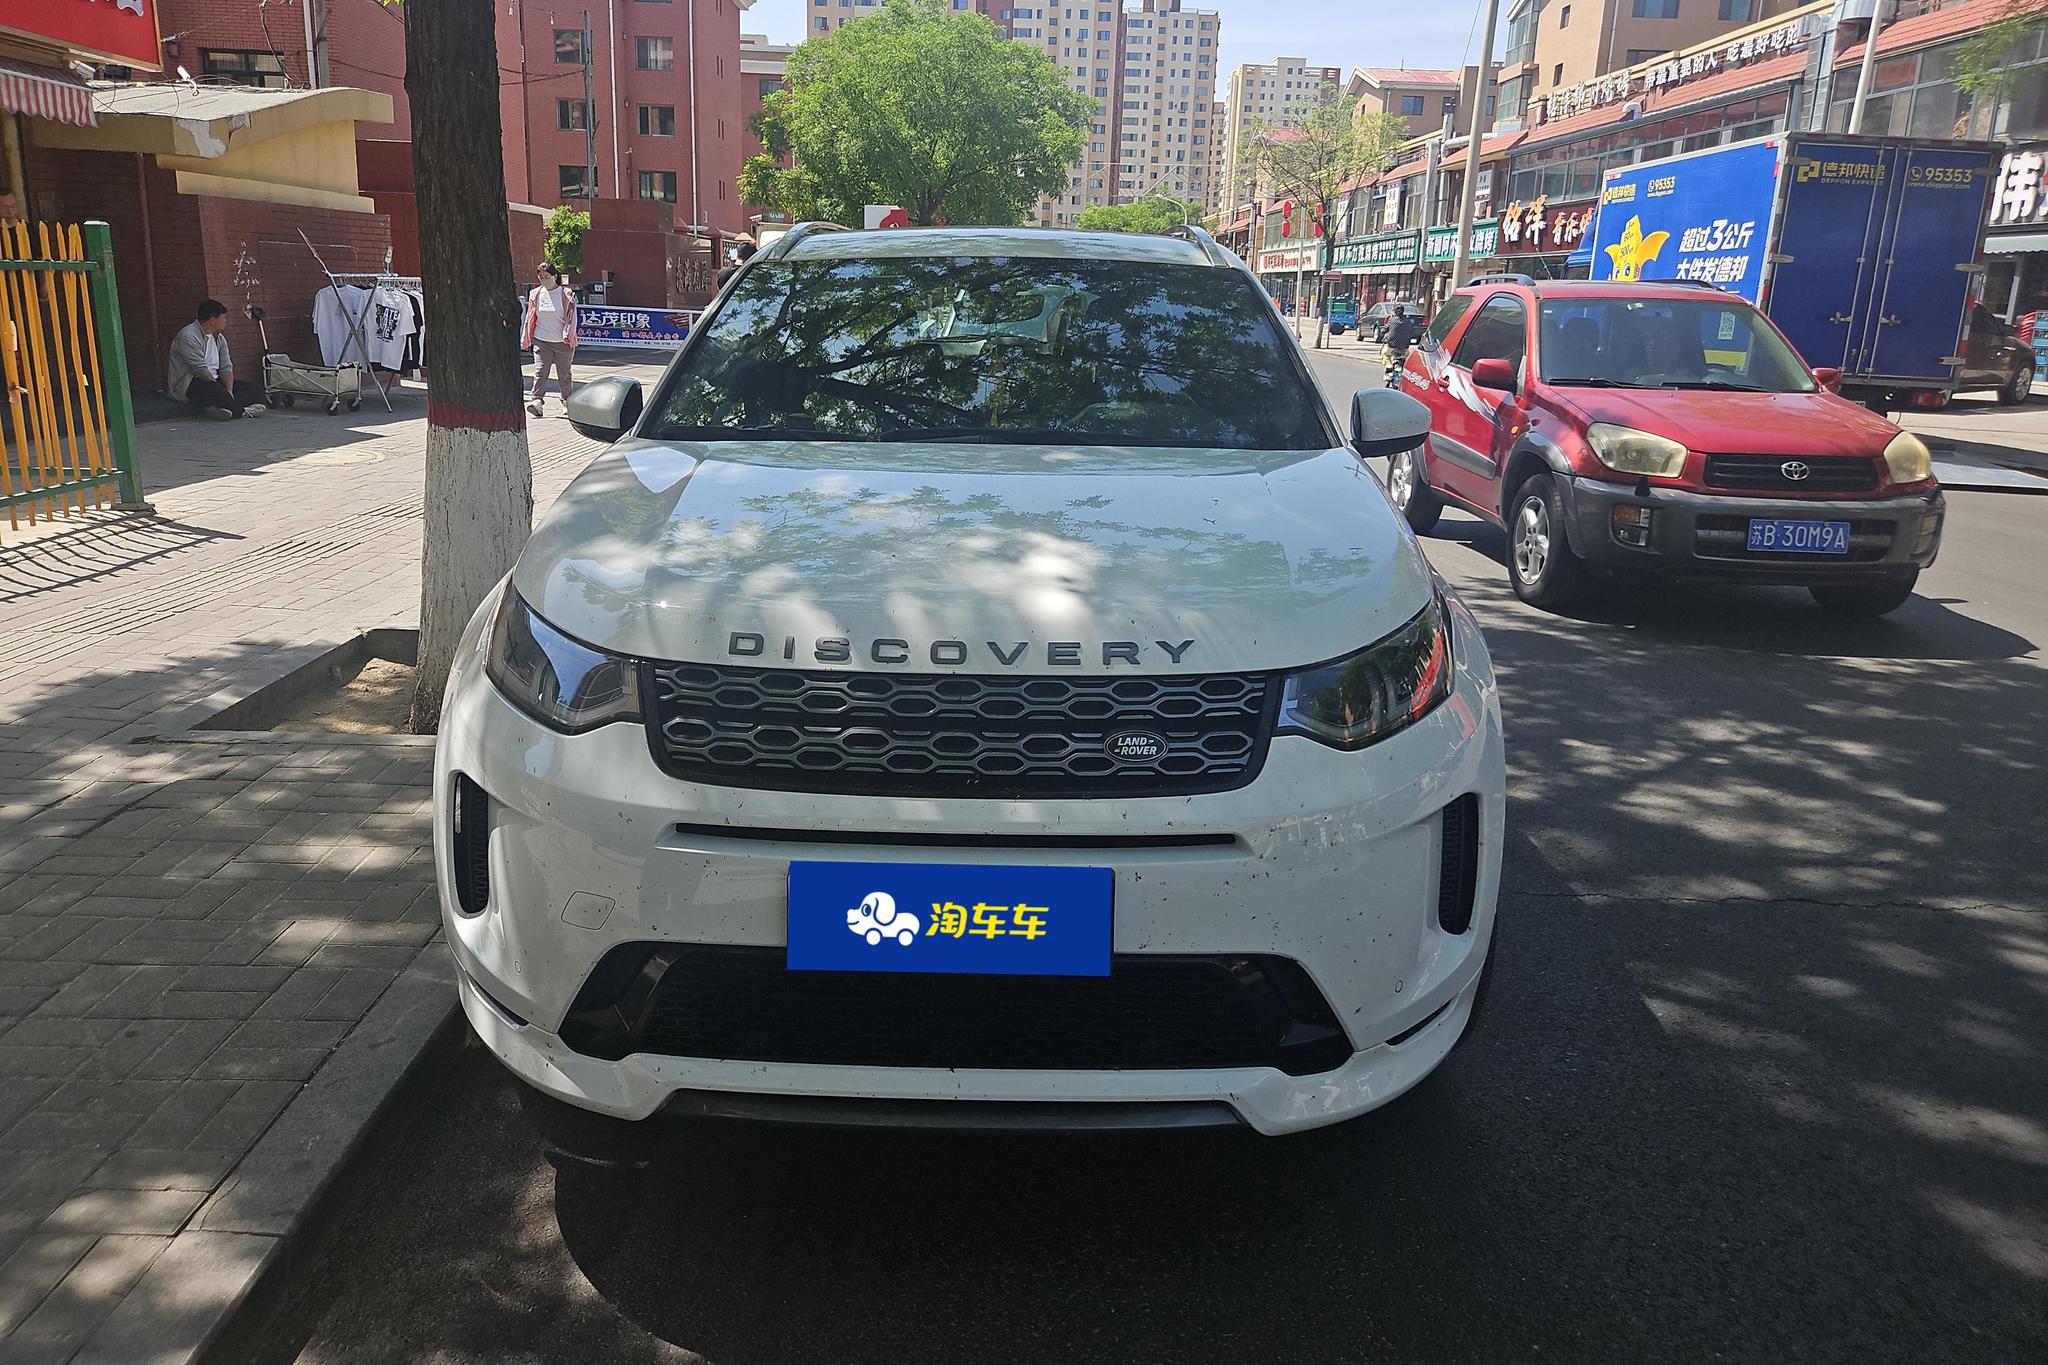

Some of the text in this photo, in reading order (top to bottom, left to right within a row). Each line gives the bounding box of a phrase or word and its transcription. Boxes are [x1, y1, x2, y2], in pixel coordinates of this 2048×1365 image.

[1822, 162, 1885, 180] 德邦快递
[1925, 167, 1973, 183] 95353
[1679, 219, 1755, 253] 超过3公斤
[1676, 256, 1749, 283] 大件发德邦
[580, 311, 651, 329] 达茂印象
[728, 631, 1195, 667] DISCOVERY
[1117, 737, 1148, 746] LAND
[1120, 746, 1158, 755] ROVER
